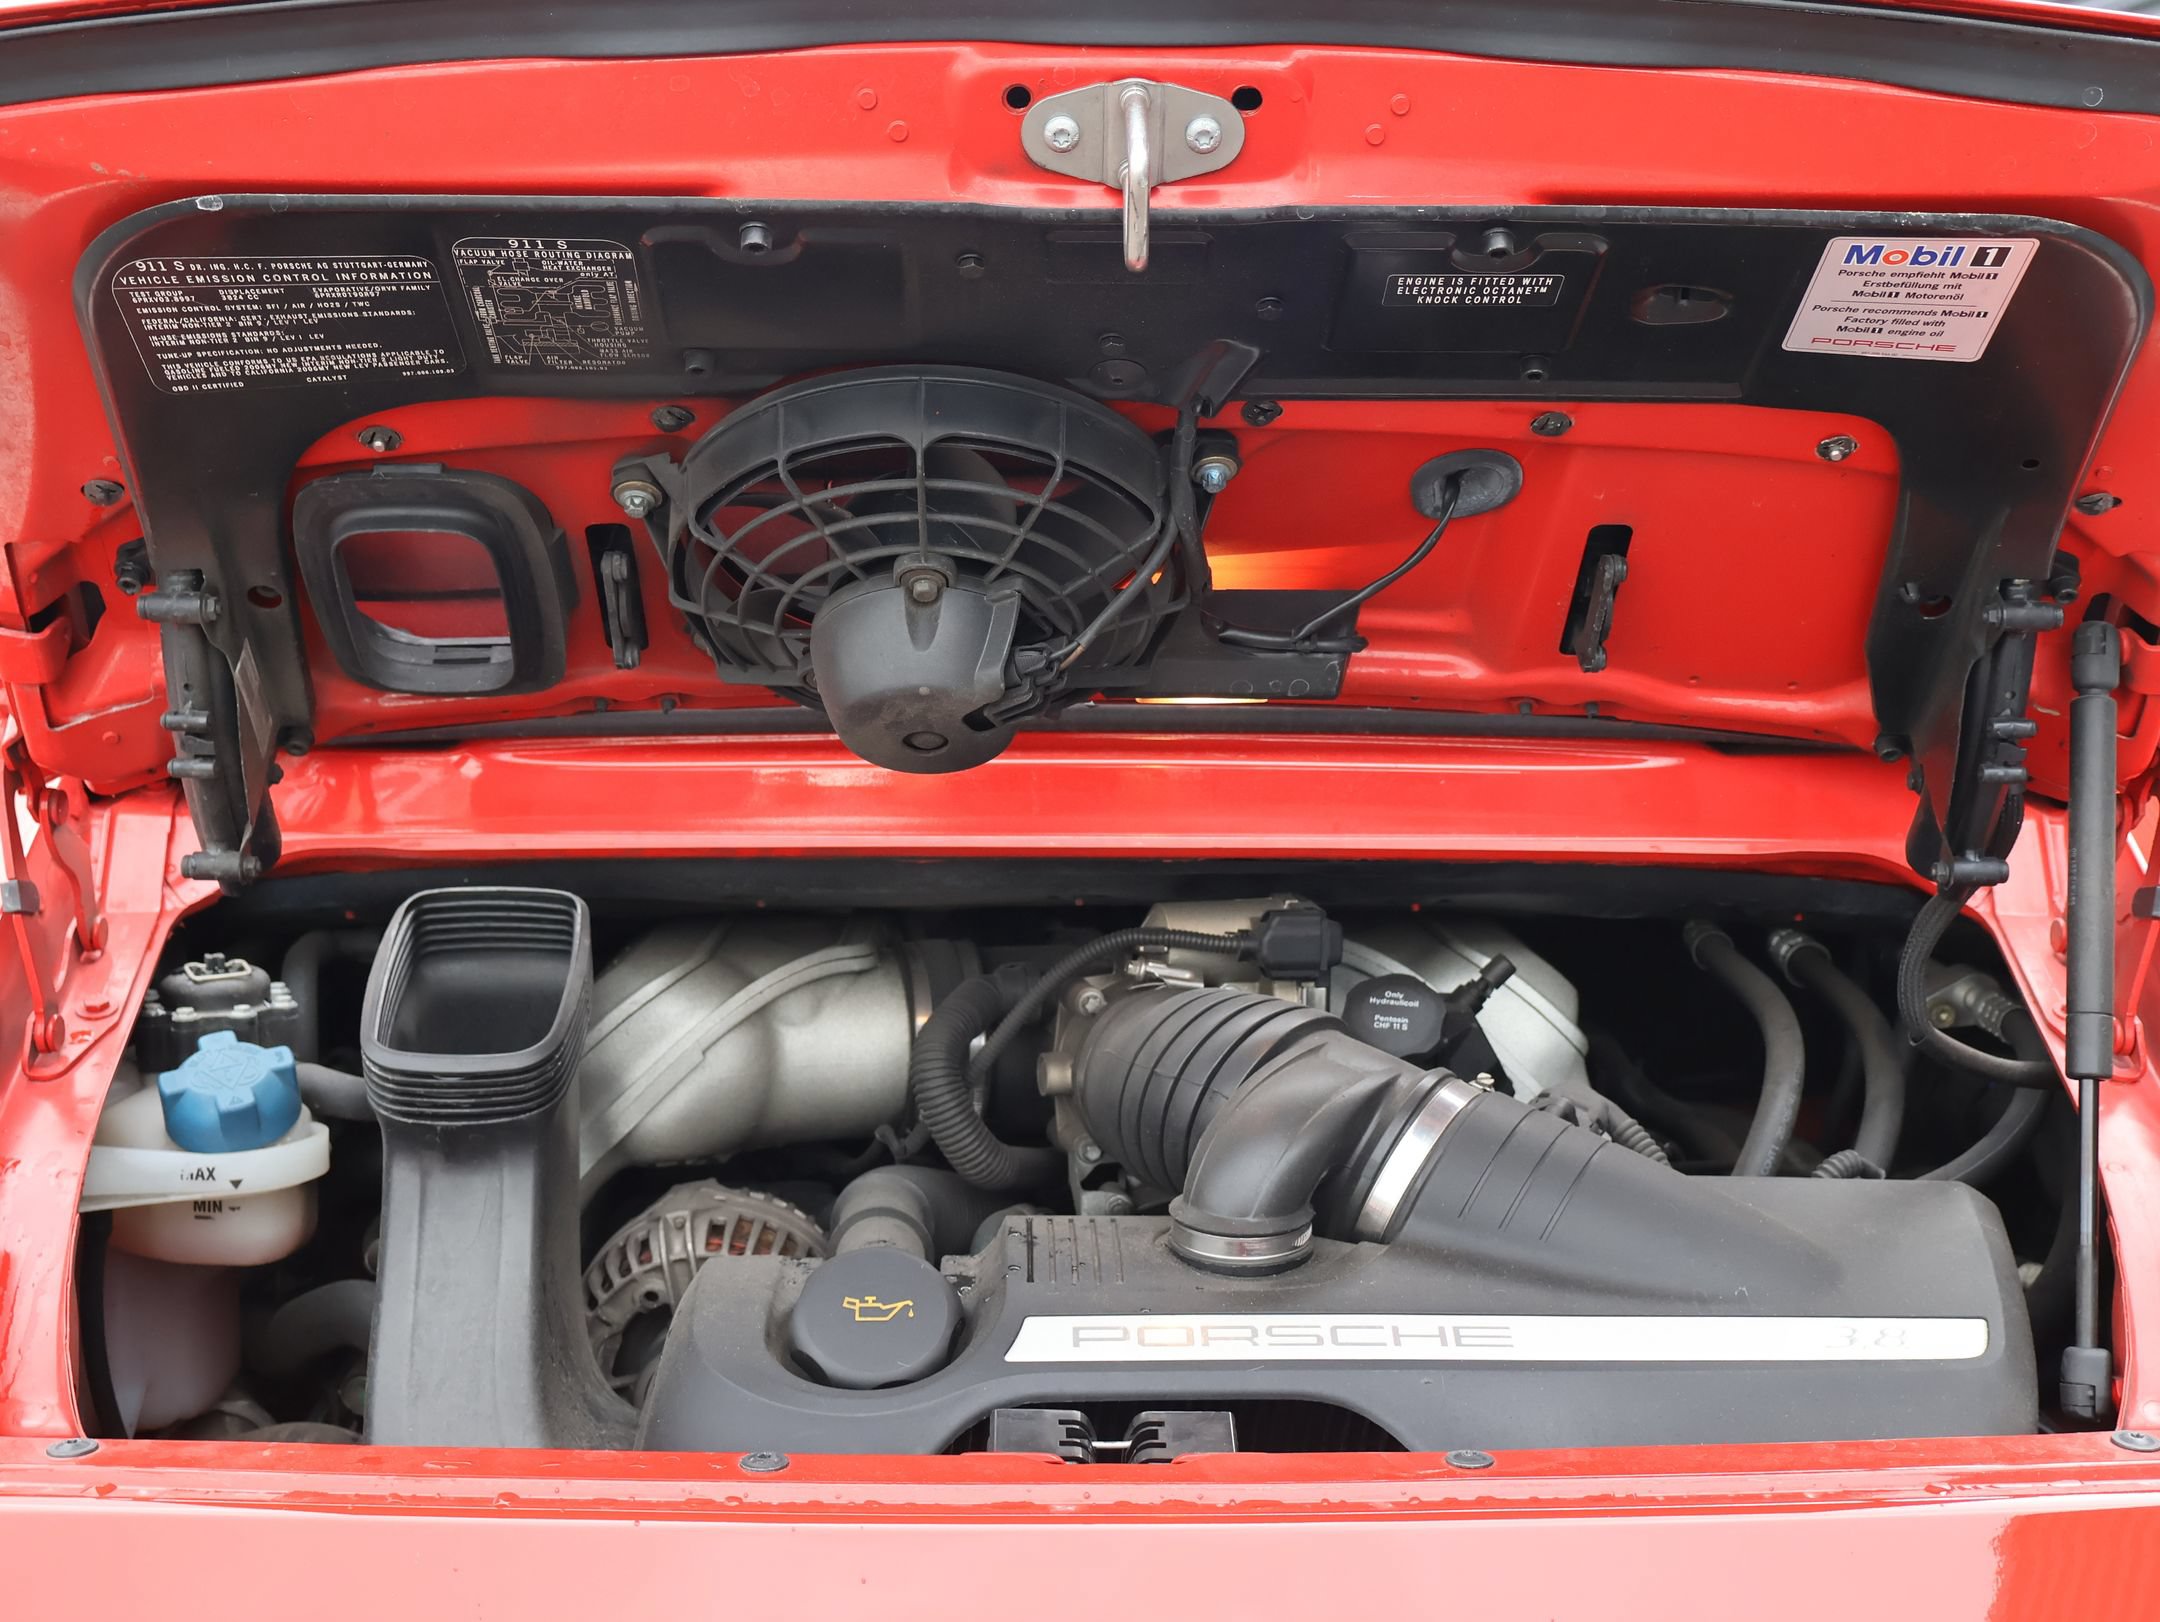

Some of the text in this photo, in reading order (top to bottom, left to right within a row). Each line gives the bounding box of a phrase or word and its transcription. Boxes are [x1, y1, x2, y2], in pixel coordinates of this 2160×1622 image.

[508, 239, 568, 249] 911 S
[454, 249, 633, 260] VACUUM HOSE ROUTING DIAGRAM
[1843, 245, 1966, 266] Mobil
[136, 261, 168, 272] 911
[173, 260, 185, 271] S
[210, 263, 230, 271] ING.
[271, 262, 312, 270] PORSCHE
[333, 261, 428, 269] STUTTGART-GERMANY
[119, 271, 432, 285] VEHICLE EMISSION CONTROL INFORMATION
[1838, 270, 1886, 278] Porsche
[1890, 271, 1946, 280] empfiehlt
[1398, 277, 1554, 286] ENGINE IS FITTED WITH
[1863, 280, 1939, 290] Erstbefüllung
[1397, 286, 1476, 295] ELECTRONIC
[1416, 296, 1522, 304] KNOCK CONTROL
[1904, 292, 1964, 301] Motorenöl
[1812, 304, 1859, 313] Porsche
[1862, 307, 1938, 316] recommends
[142, 316, 237, 325] FEDERAL/CALIFORNIA:
[1844, 316, 1889, 325] Factory
[1890, 318, 1920, 326] filled
[144, 323, 179, 331] INTERIM
[190, 338, 230, 346] NON-TIER
[1811, 337, 1957, 352] PORSCHE
[156, 352, 193, 360] TUNE-UP
[196, 349, 264, 357] SPECIFICATION:
[282, 344, 342, 353] ADJUSTMENTS
[320, 352, 377, 361] REGULATIONS
[166, 373, 207, 381] VEHICLES
[245, 368, 293, 376] CALIFORNIA
[372, 360, 422, 368] PASSENGER
[306, 375, 347, 383] CATALYST
[201, 382, 244, 390] CERTIFIED
[1384, 991, 1404, 1000] Only
[193, 1200, 223, 1213] MIN
[1071, 1324, 1515, 1349] PORSCHE
